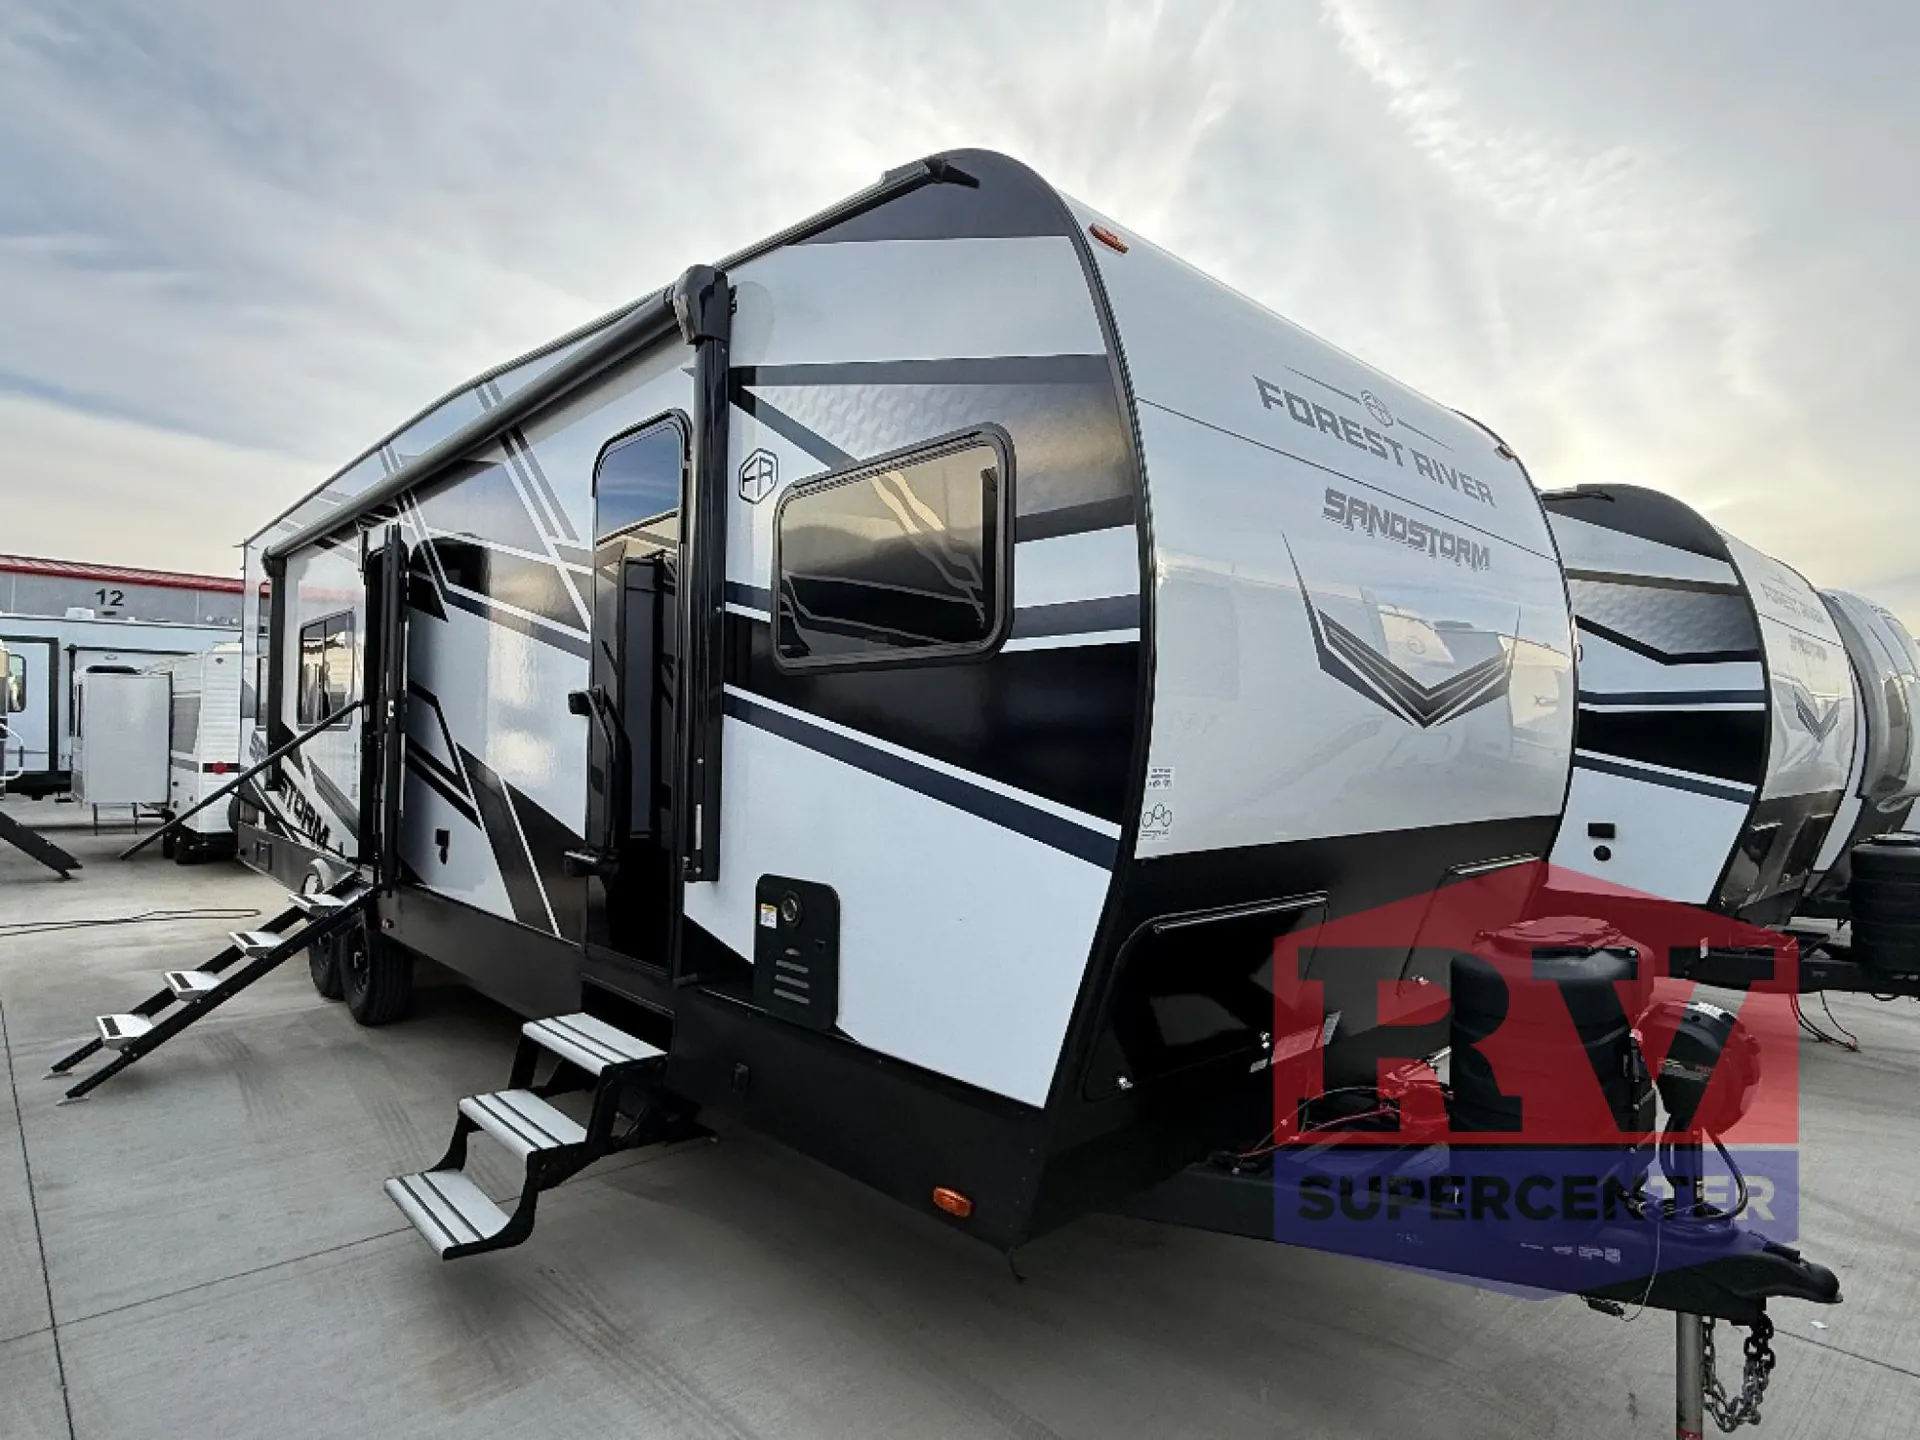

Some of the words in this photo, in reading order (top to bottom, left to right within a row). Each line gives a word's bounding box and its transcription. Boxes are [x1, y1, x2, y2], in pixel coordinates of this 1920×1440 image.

[1252, 374, 1404, 467] FOREST
[1408, 447, 1497, 508] RIVER
[1322, 487, 1491, 572] SANDSTORM
[95, 588, 125, 607] 12
